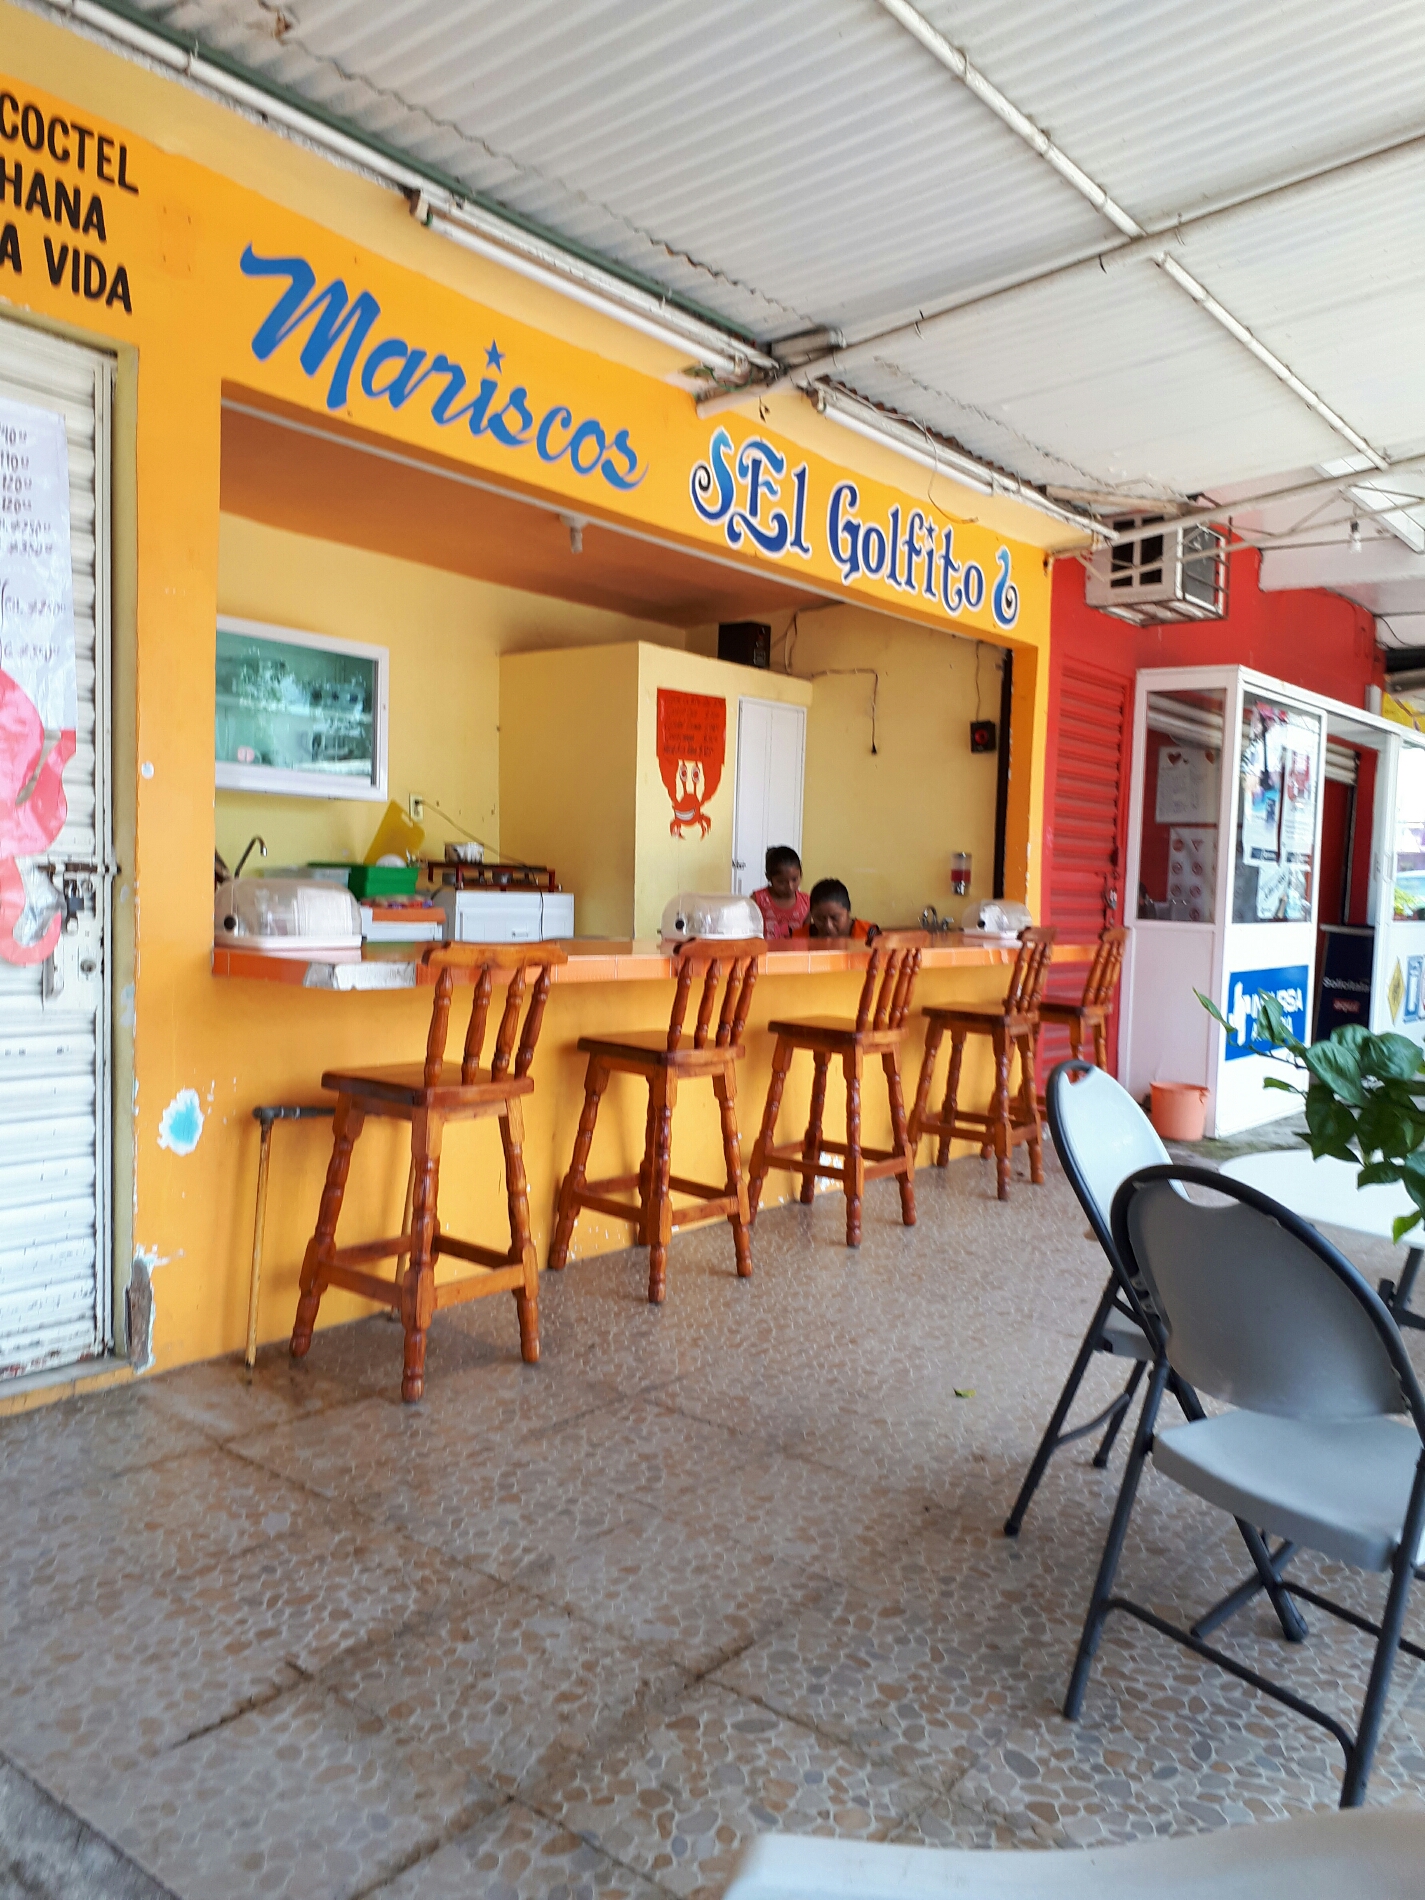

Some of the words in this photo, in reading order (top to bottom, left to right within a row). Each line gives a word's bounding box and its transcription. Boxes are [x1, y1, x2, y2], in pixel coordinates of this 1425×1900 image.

[0, 92, 140, 194] COCTEL
[43, 235, 132, 315] VIDA
[240, 242, 650, 490] Mariscos
[826, 481, 987, 614] Golfito
